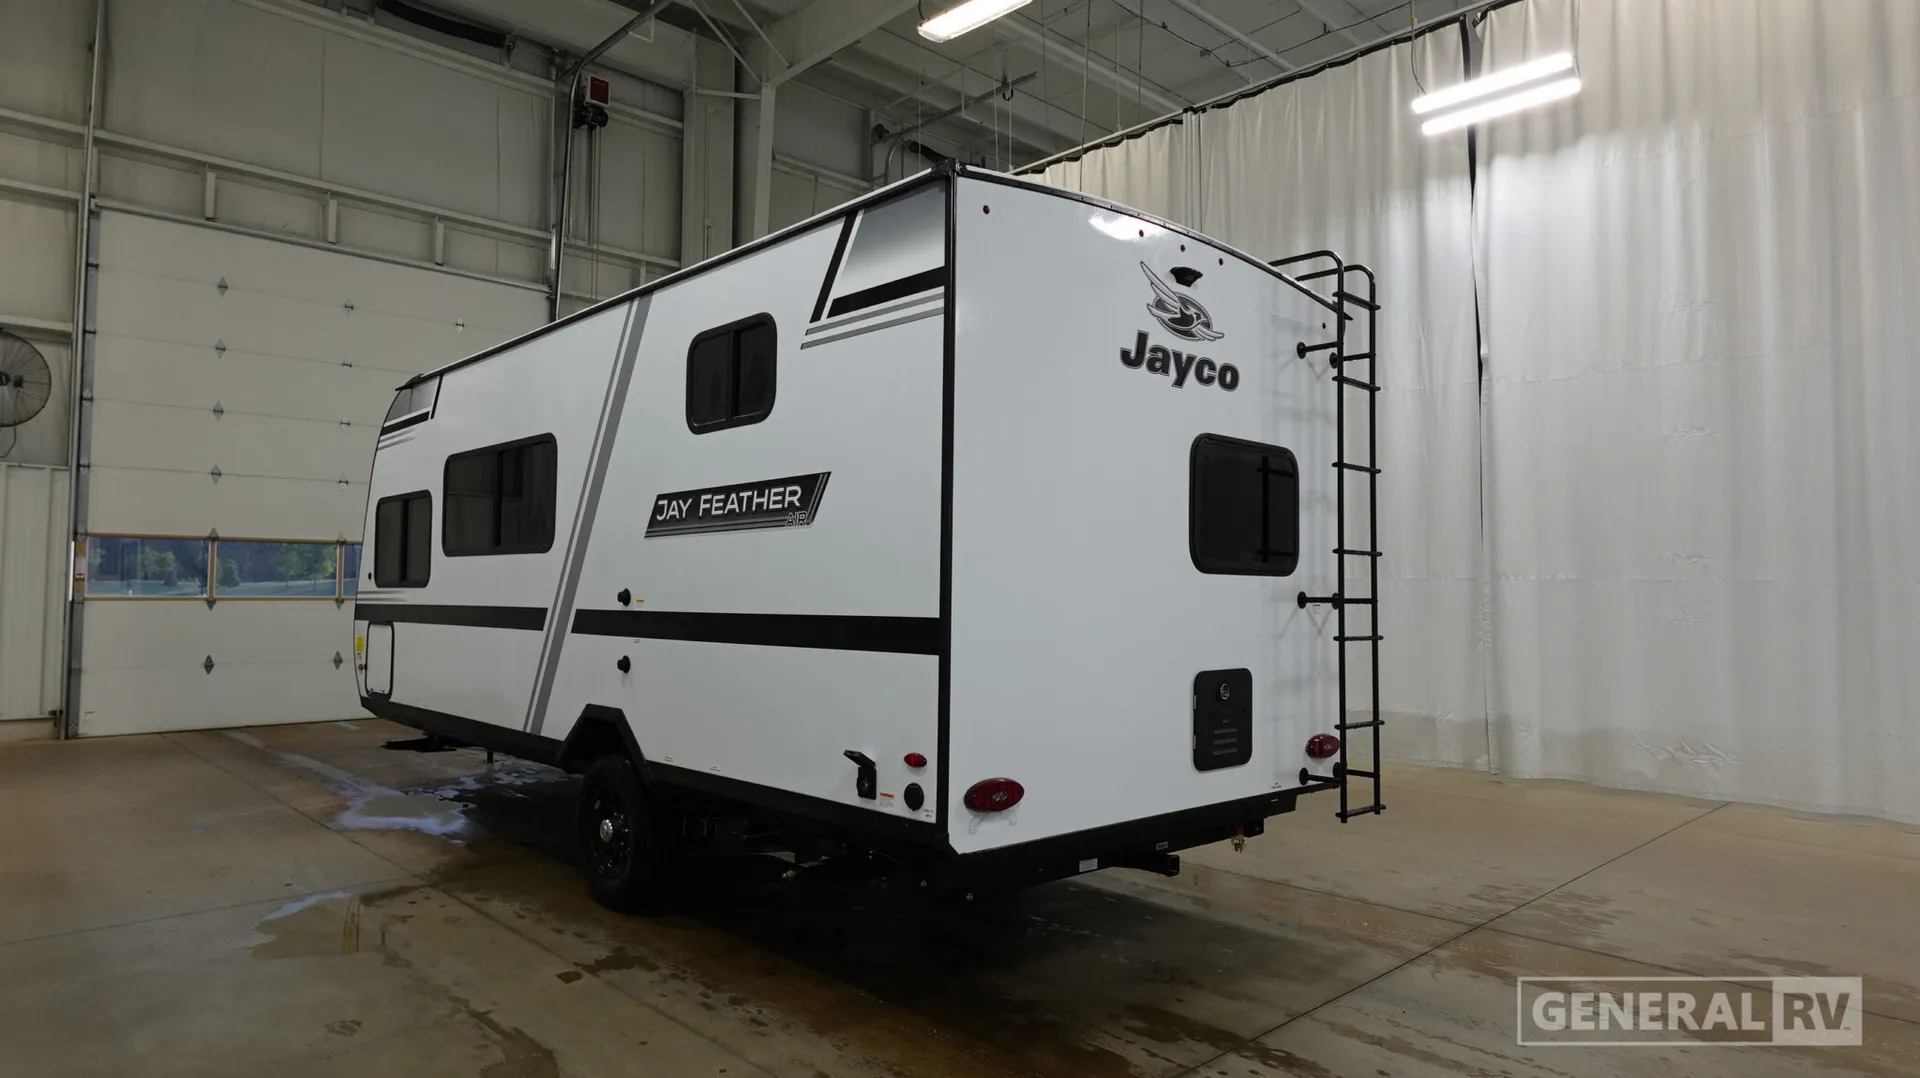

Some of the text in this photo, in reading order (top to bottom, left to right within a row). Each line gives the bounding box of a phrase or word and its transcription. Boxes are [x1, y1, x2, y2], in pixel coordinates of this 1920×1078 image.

[1120, 329, 1240, 392] Jayco
[656, 485, 801, 521] JAY FEATHER
[785, 511, 808, 527] AIR
